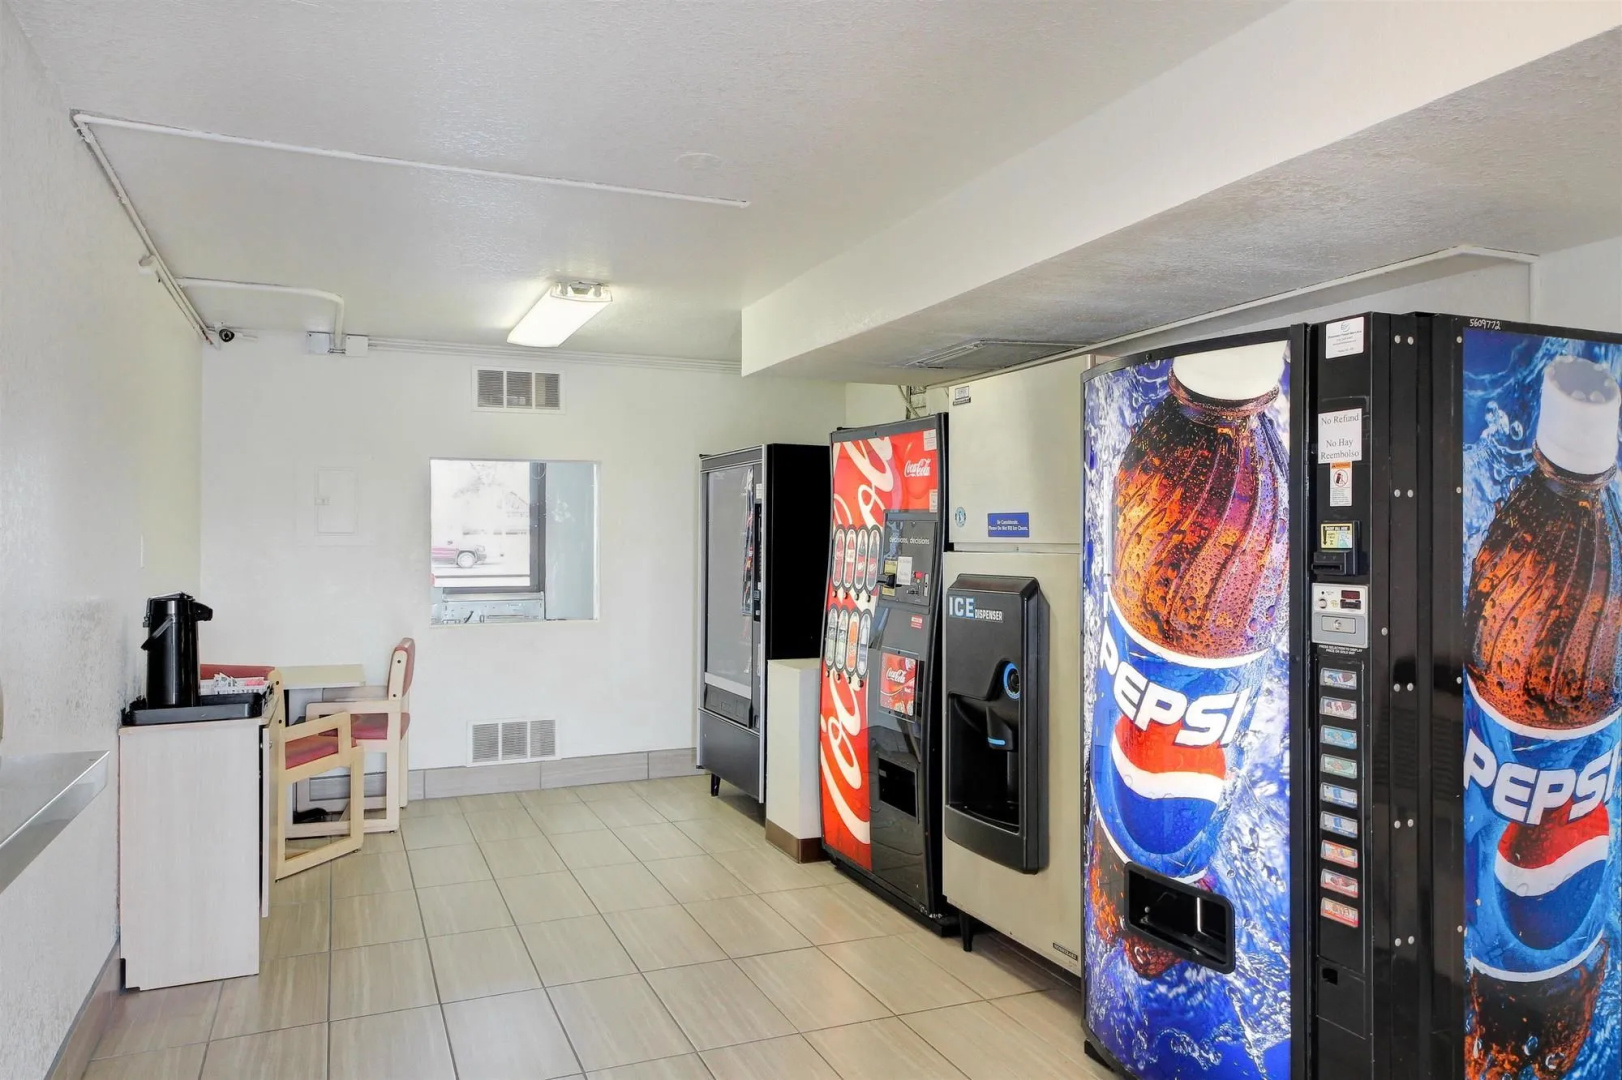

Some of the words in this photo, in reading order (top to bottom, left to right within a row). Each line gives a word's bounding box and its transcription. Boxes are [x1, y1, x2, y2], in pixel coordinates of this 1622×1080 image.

[1469, 318, 1501, 330] 5609772
[1321, 416, 1331, 425] No
[1333, 413, 1359, 424] Refund
[1326, 439, 1337, 447] No
[1338, 438, 1353, 448] Hay
[1320, 449, 1359, 460] Reembolso
[910, 536, 930, 545] decisions
[949, 596, 975, 618] ICE
[975, 609, 1003, 621] DISPENSER
[1099, 622, 1252, 747] PEPSI
[1463, 728, 1620, 826] PEPSI
